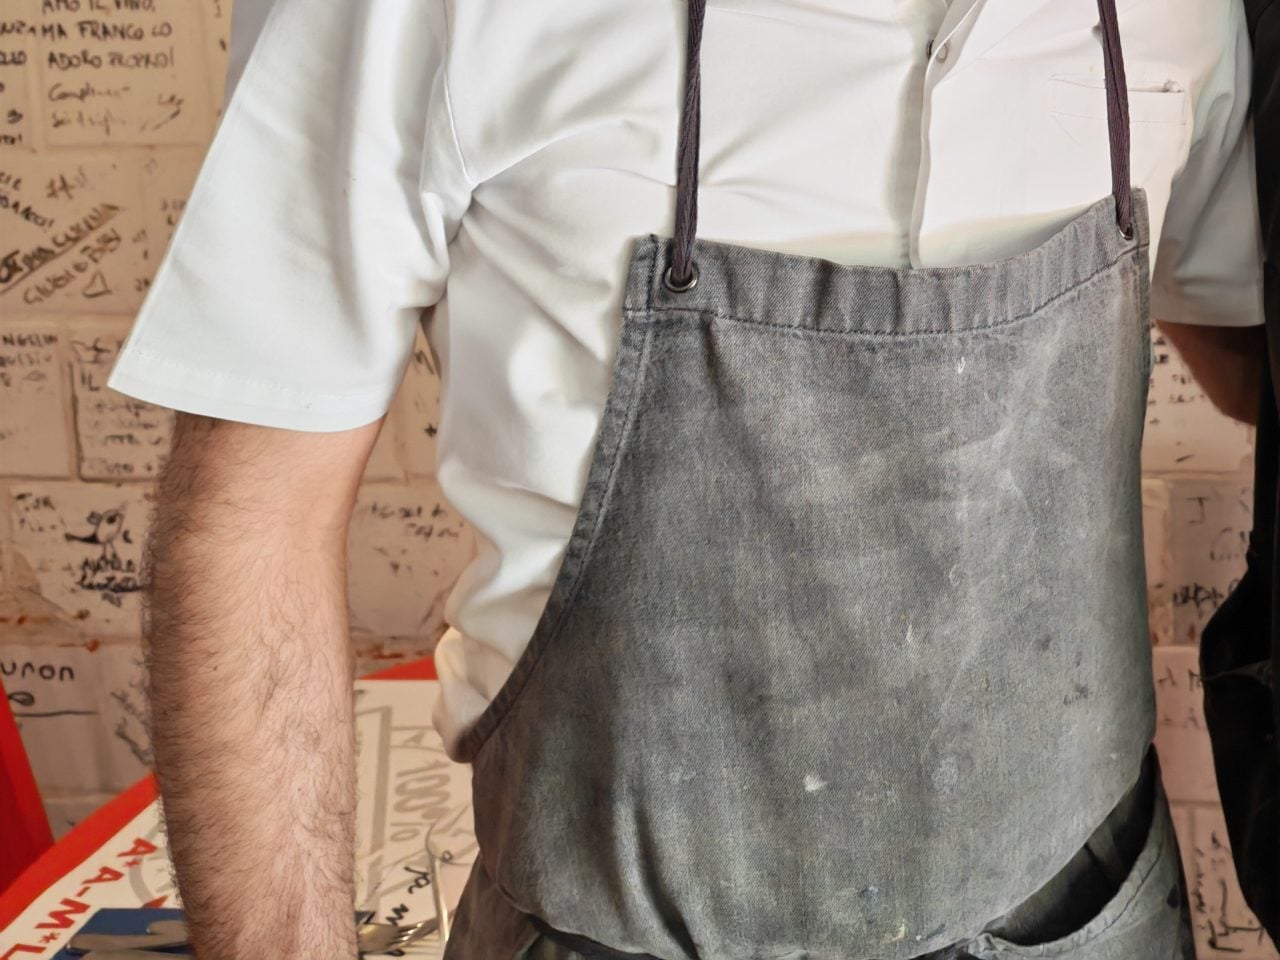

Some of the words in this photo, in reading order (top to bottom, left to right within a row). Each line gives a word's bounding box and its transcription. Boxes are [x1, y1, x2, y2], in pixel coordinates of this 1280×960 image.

[42, 22, 67, 40] MA
[78, 20, 144, 40] FRANCO
[48, 49, 102, 70] ADORO
